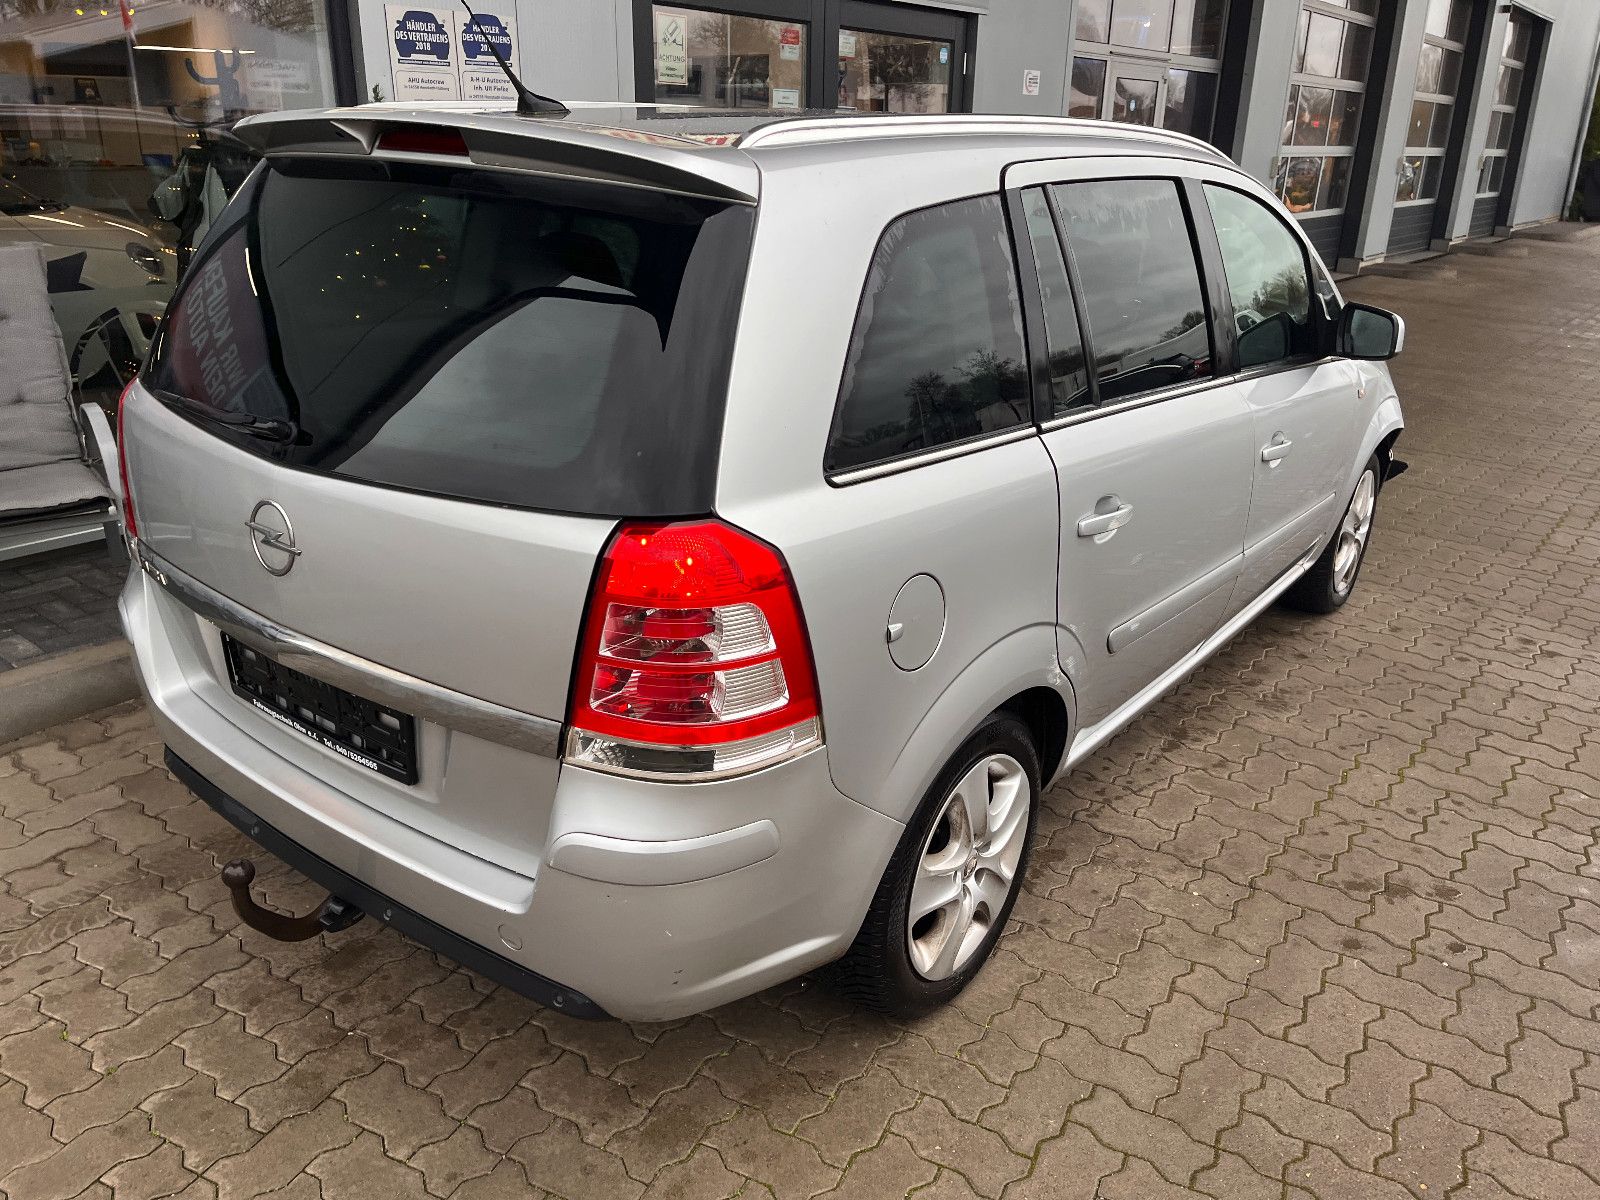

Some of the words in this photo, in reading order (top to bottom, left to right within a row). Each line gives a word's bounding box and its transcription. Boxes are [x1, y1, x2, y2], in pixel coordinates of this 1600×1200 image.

[406, 20, 436, 32] HÄNDLER
[395, 30, 408, 40] DES
[408, 31, 449, 43] VERTRAUENS
[462, 33, 474, 42] DES
[415, 42, 431, 51] 2018
[659, 54, 686, 62] ACHTUNG
